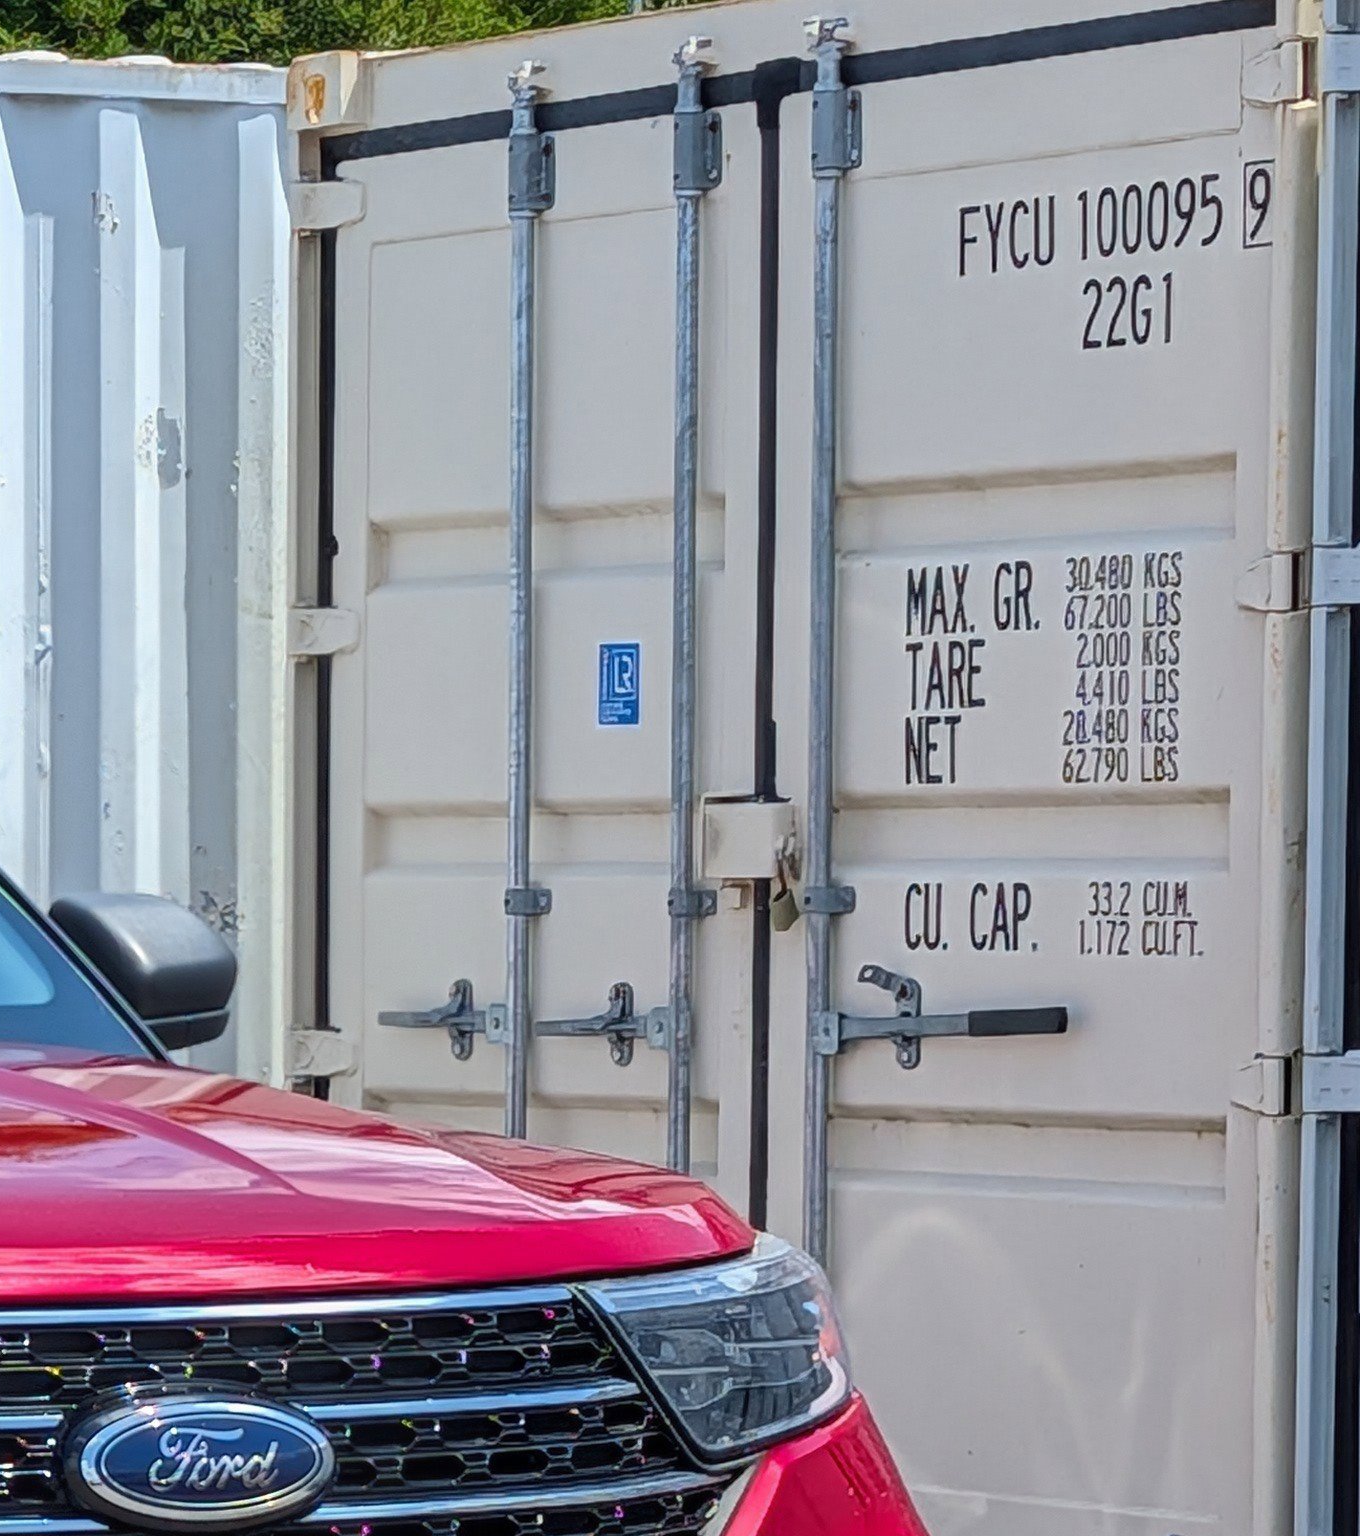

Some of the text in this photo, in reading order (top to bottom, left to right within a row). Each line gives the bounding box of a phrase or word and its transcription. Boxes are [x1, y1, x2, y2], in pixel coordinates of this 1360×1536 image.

[959, 168, 1271, 277] FYCU 100095 9
[1082, 273, 1174, 349] 22G1
[906, 563, 976, 637] MAX.
[994, 560, 1040, 631] GR.
[1144, 551, 1183, 588] KGS
[1142, 590, 1182, 628] LBS
[905, 639, 986, 711] TARE
[1141, 630, 1181, 666] KGS
[1141, 668, 1180, 705] LBS
[905, 715, 962, 784] NET
[1141, 707, 1179, 743] KGS
[1140, 745, 1179, 782] LBS
[904, 882, 948, 951] CU.
[969, 882, 1038, 951] CAP.
[1088, 881, 1131, 916] 33.2
[148, 1426, 279, 1492] Ford
